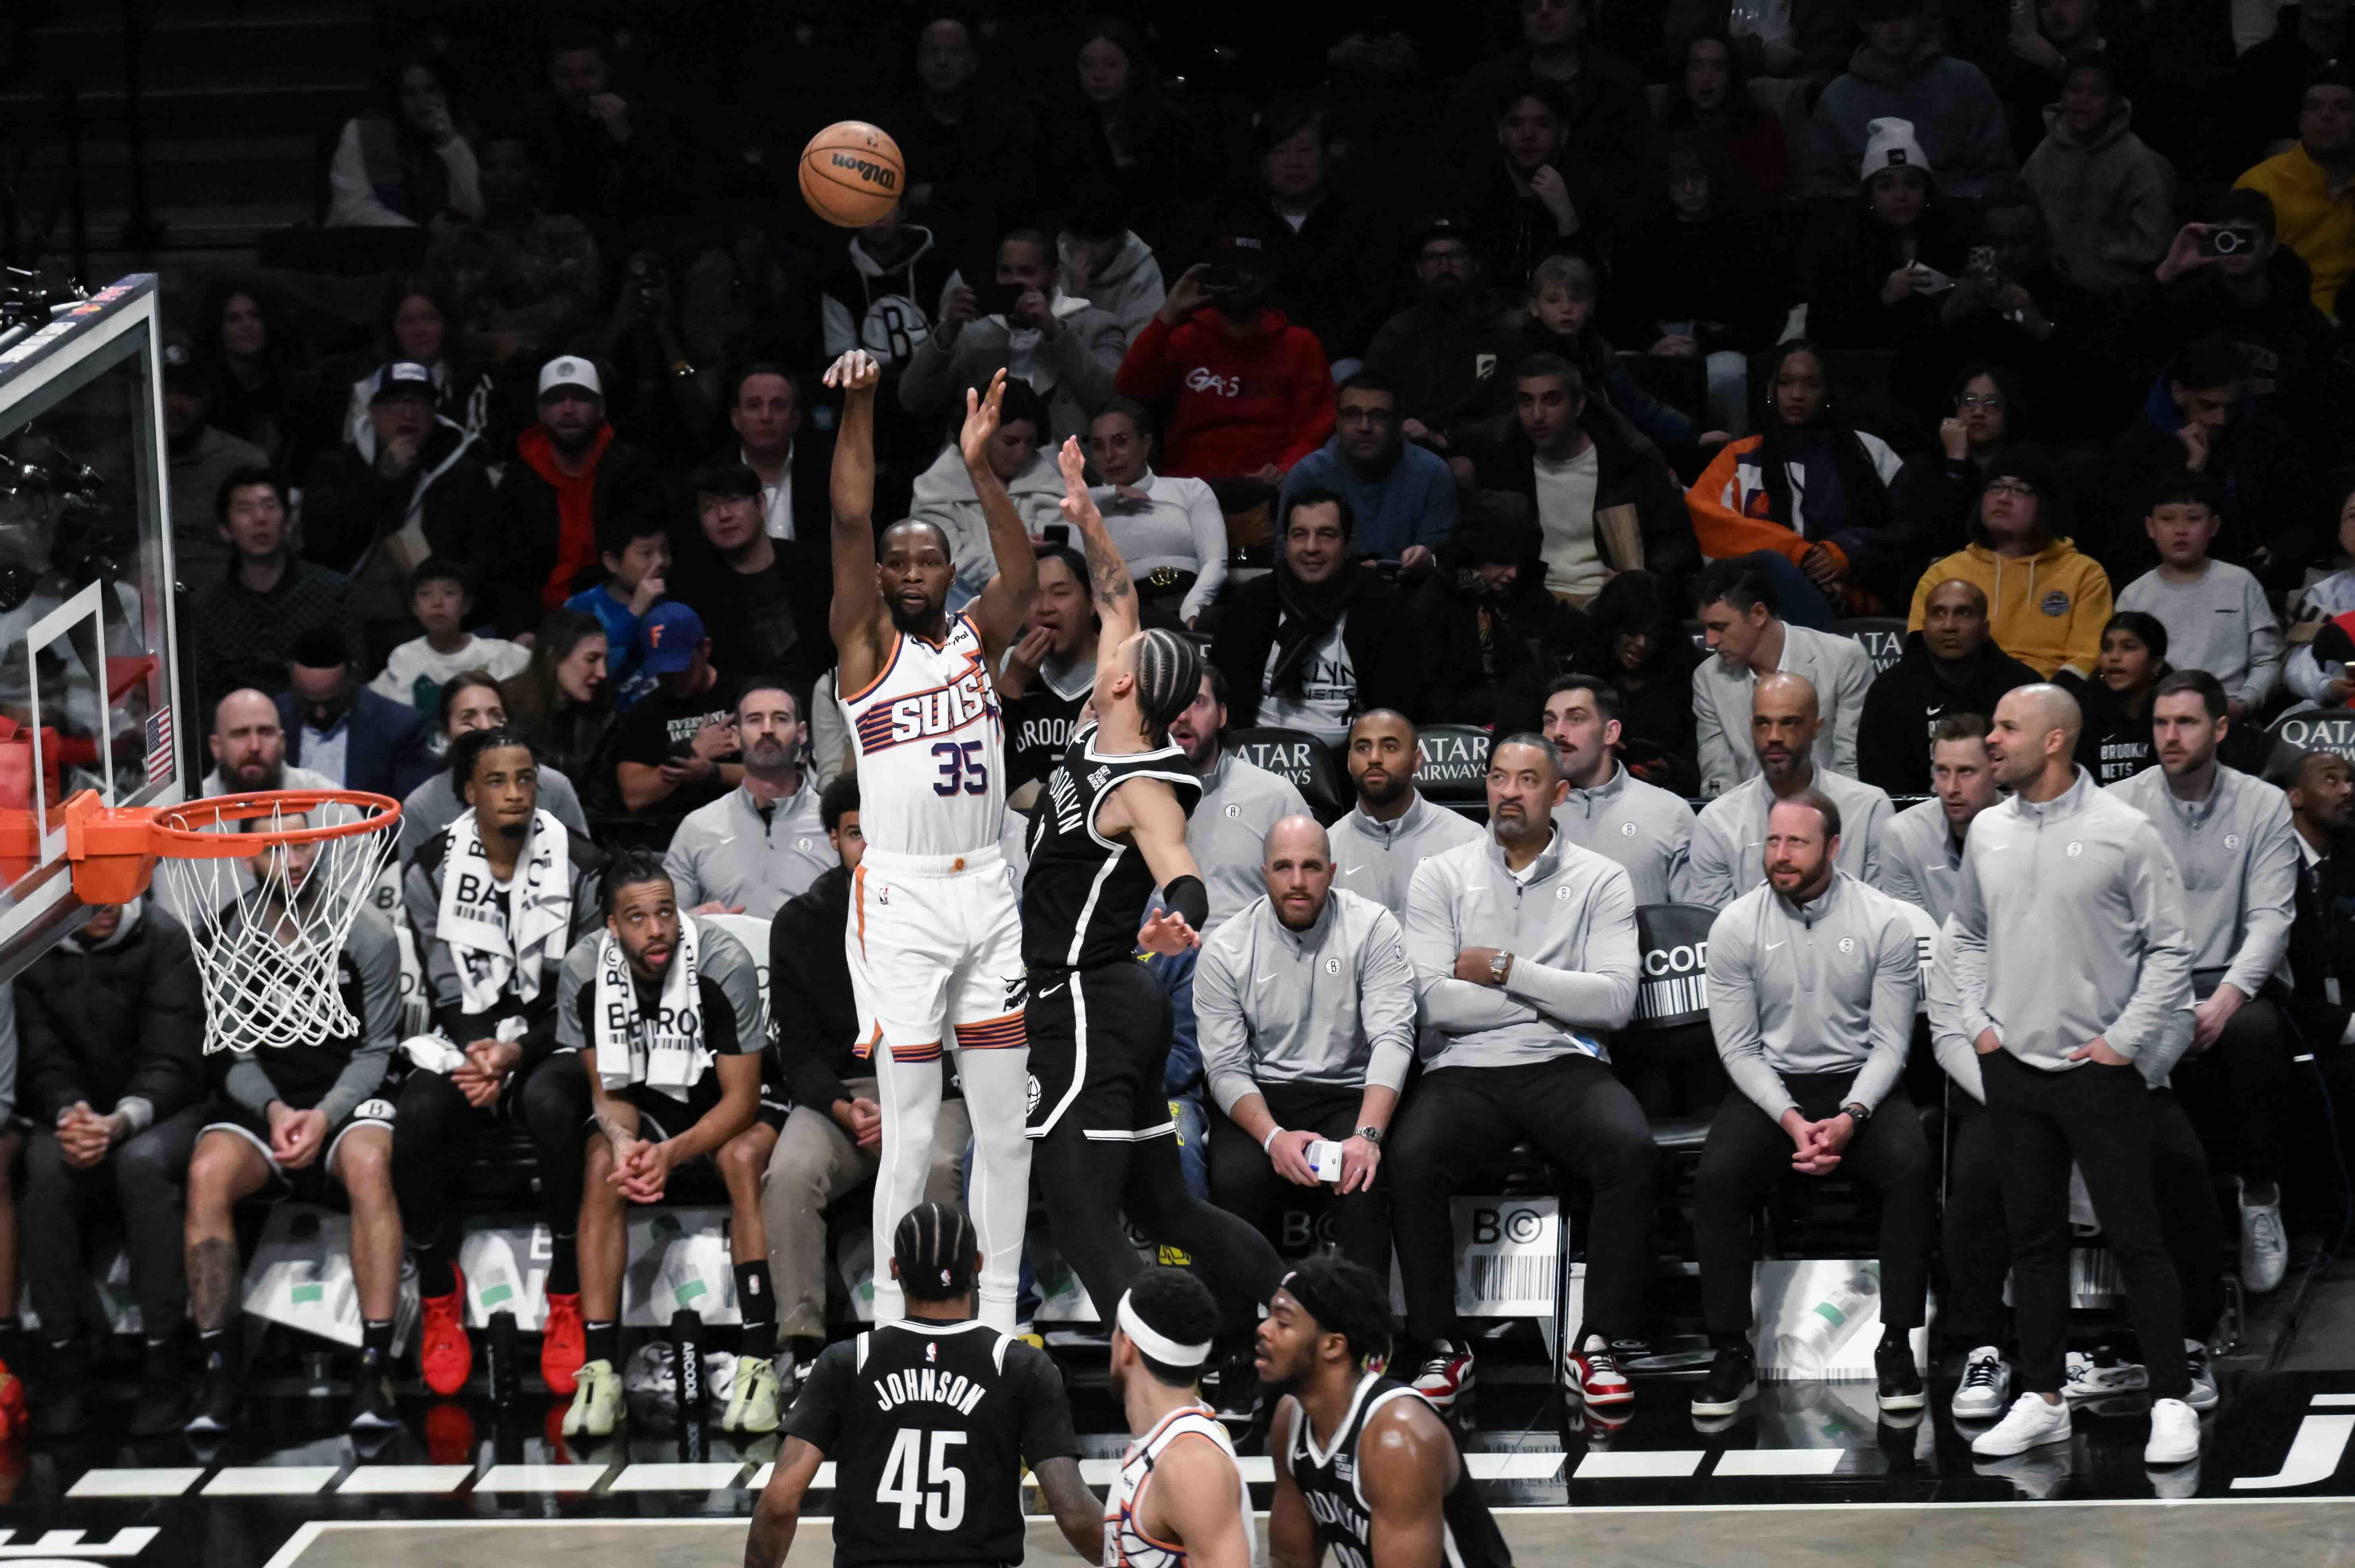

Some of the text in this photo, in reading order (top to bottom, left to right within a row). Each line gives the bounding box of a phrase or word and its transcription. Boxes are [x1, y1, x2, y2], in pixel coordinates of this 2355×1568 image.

[832, 153, 896, 190] Wilson
[650, 623, 666, 648] F
[945, 630, 969, 646] ayPal
[1236, 743, 1311, 768] ATAR
[1417, 737, 1490, 762] ATAR
[931, 740, 988, 797] 35
[1050, 766, 1083, 834] OOKLYN
[458, 874, 497, 906] BA
[874, 1369, 986, 1416] JOHNSON
[876, 1429, 967, 1531] 45
